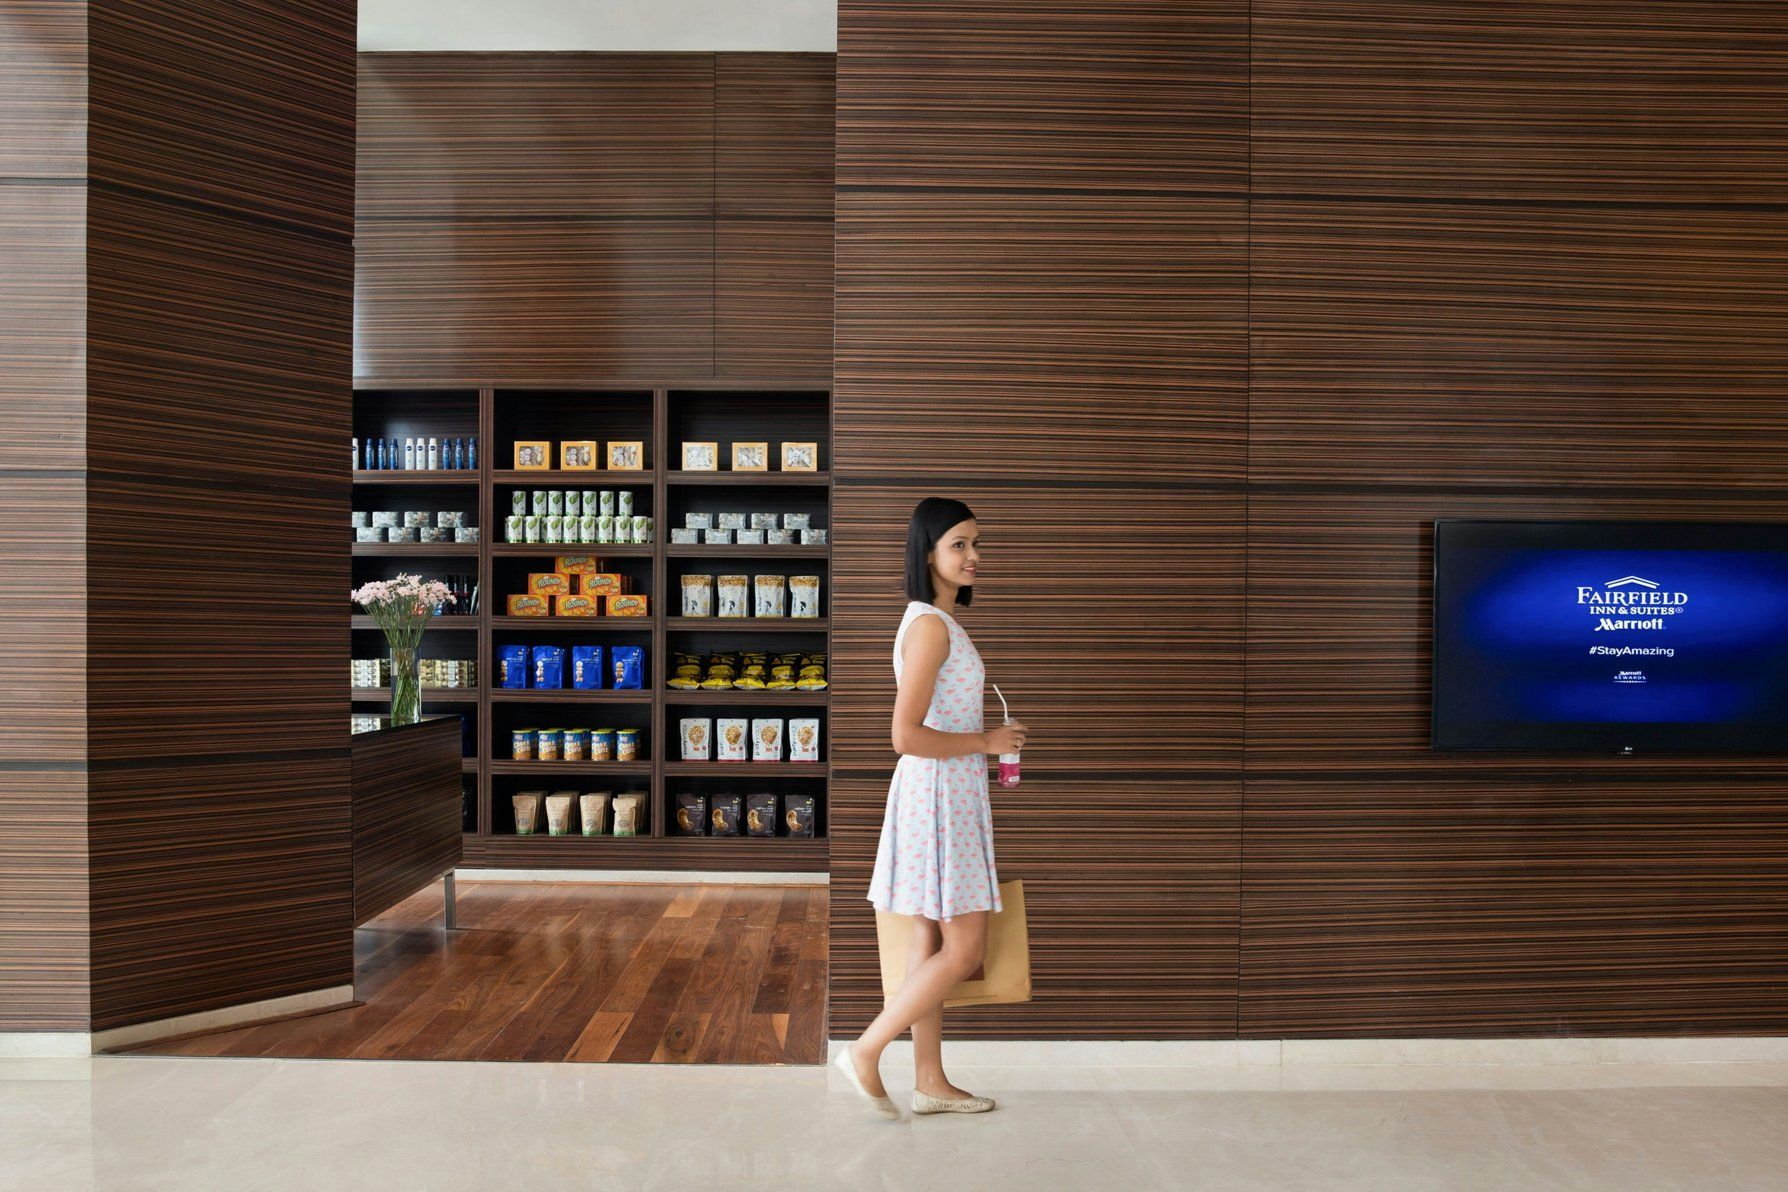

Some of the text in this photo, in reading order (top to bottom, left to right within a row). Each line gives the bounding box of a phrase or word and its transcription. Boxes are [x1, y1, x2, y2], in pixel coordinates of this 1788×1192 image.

[1577, 587, 1688, 606] FAIRFIELD
[1590, 607, 1616, 615] INN
[1618, 607, 1628, 615] &
[1594, 618, 1663, 631] Marriott
[1589, 646, 1674, 657] #StayAmazing
